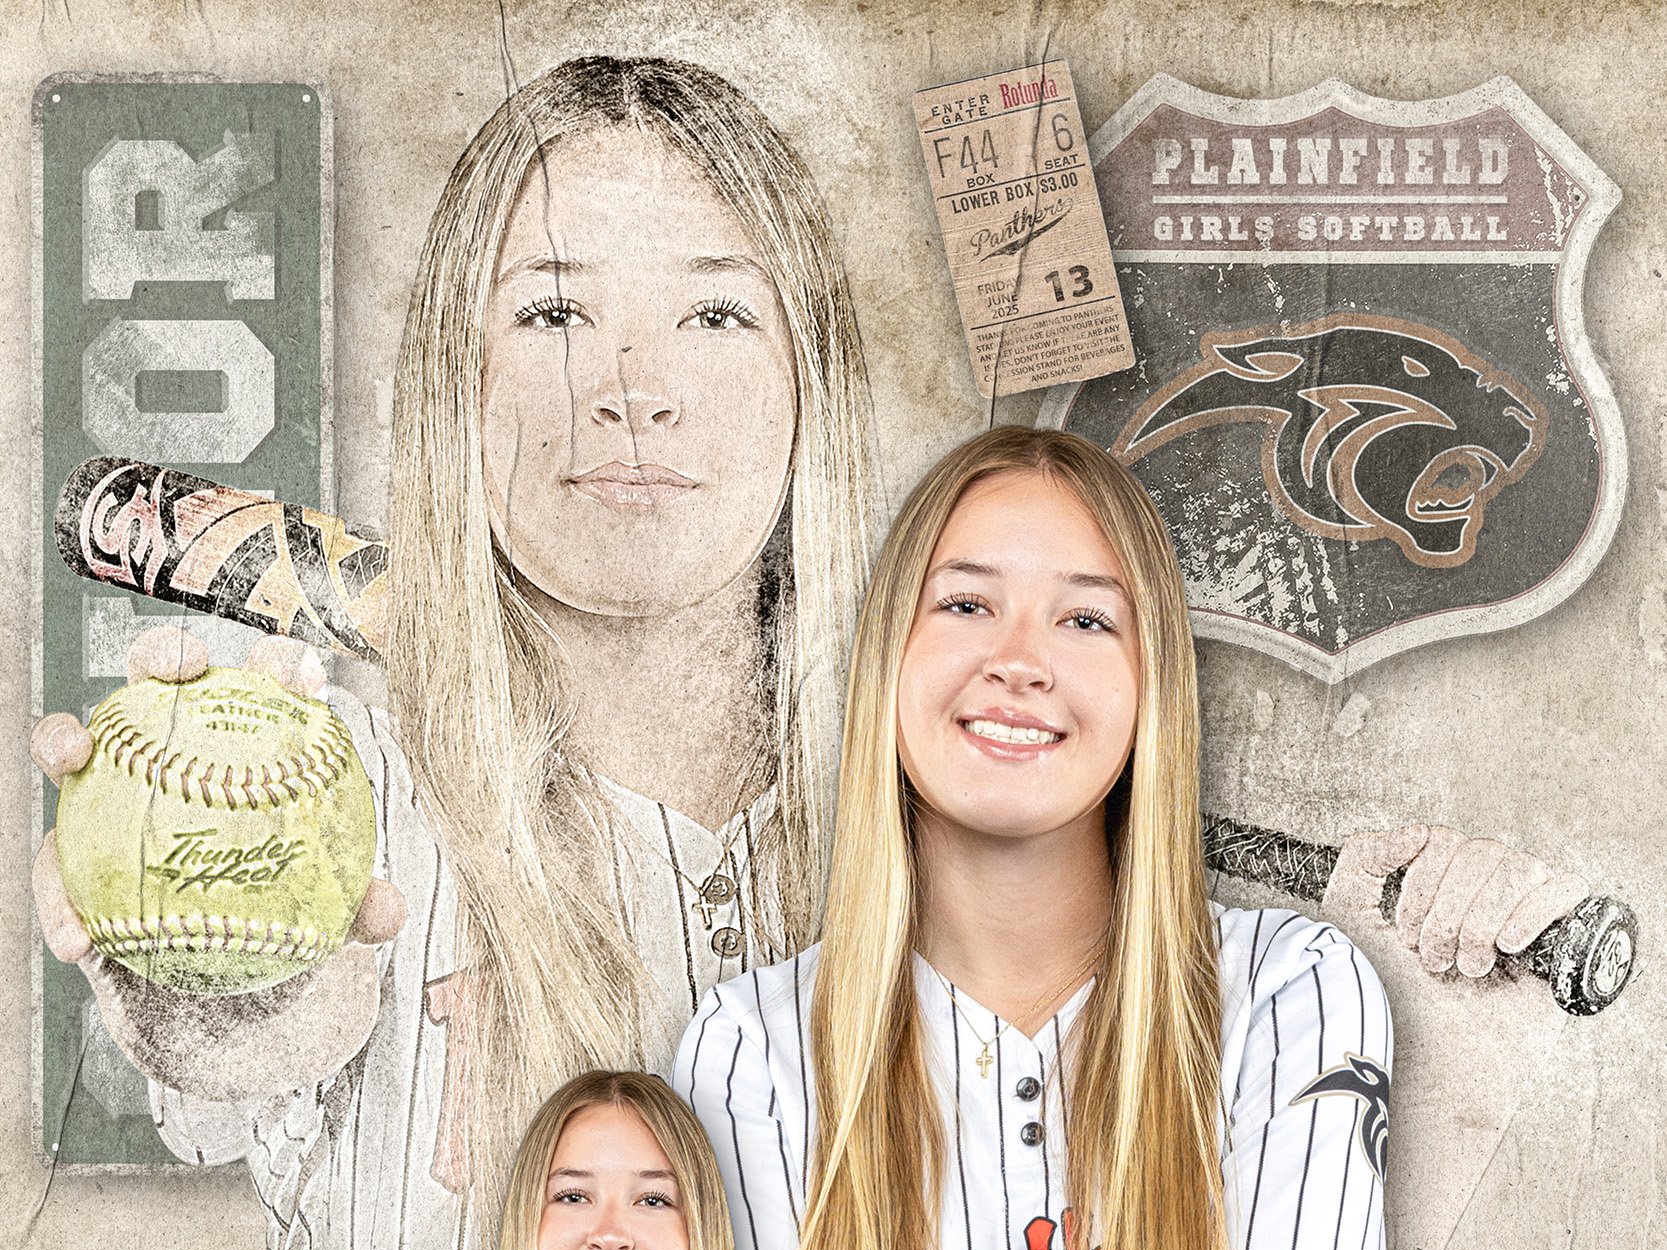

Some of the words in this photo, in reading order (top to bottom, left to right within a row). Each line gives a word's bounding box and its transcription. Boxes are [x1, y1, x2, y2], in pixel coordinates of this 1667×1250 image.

[931, 94, 991, 117] ENTER
[999, 78, 1059, 110] Rotunda
[942, 106, 988, 125] GATE
[1051, 113, 1074, 152] 6
[933, 129, 999, 178] F44
[1044, 154, 1079, 170] SEAT
[1151, 138, 1510, 185] PLAINFIELD
[966, 173, 996, 189] BOX
[952, 190, 1001, 214] LOWER
[1005, 182, 1035, 202] BOX
[970, 197, 1073, 256] Panthers
[1153, 216, 1275, 242] GIRLS
[1297, 216, 1509, 242] SOFTBALL
[977, 276, 1018, 296] FRIDAY
[1044, 264, 1094, 302] 13
[987, 294, 1019, 308] JUNE
[992, 304, 1020, 319] 2025
[1014, 331, 1044, 344] PLEASE
[1071, 320, 1093, 331] YOUR
[1094, 314, 1119, 325] EVENT
[1027, 317, 1060, 330] OMING
[1061, 314, 1072, 322] TO
[1014, 346, 1024, 354] US
[1026, 340, 1050, 351] KNOW
[1061, 332, 1086, 343] TRE
[1086, 328, 1102, 337] ARE
[1103, 324, 1120, 334] ANY
[983, 364, 1034, 382] CSSION
[1035, 358, 1062, 370] STAND
[1062, 354, 1079, 364] FOR
[1013, 352, 1039, 365] DON'T
[1040, 345, 1071, 359] FORGET
[1072, 343, 1083, 351] TO
[1030, 372, 1048, 381] AND
[164, 828, 305, 866] Thunder
[175, 849, 308, 894] Heat
